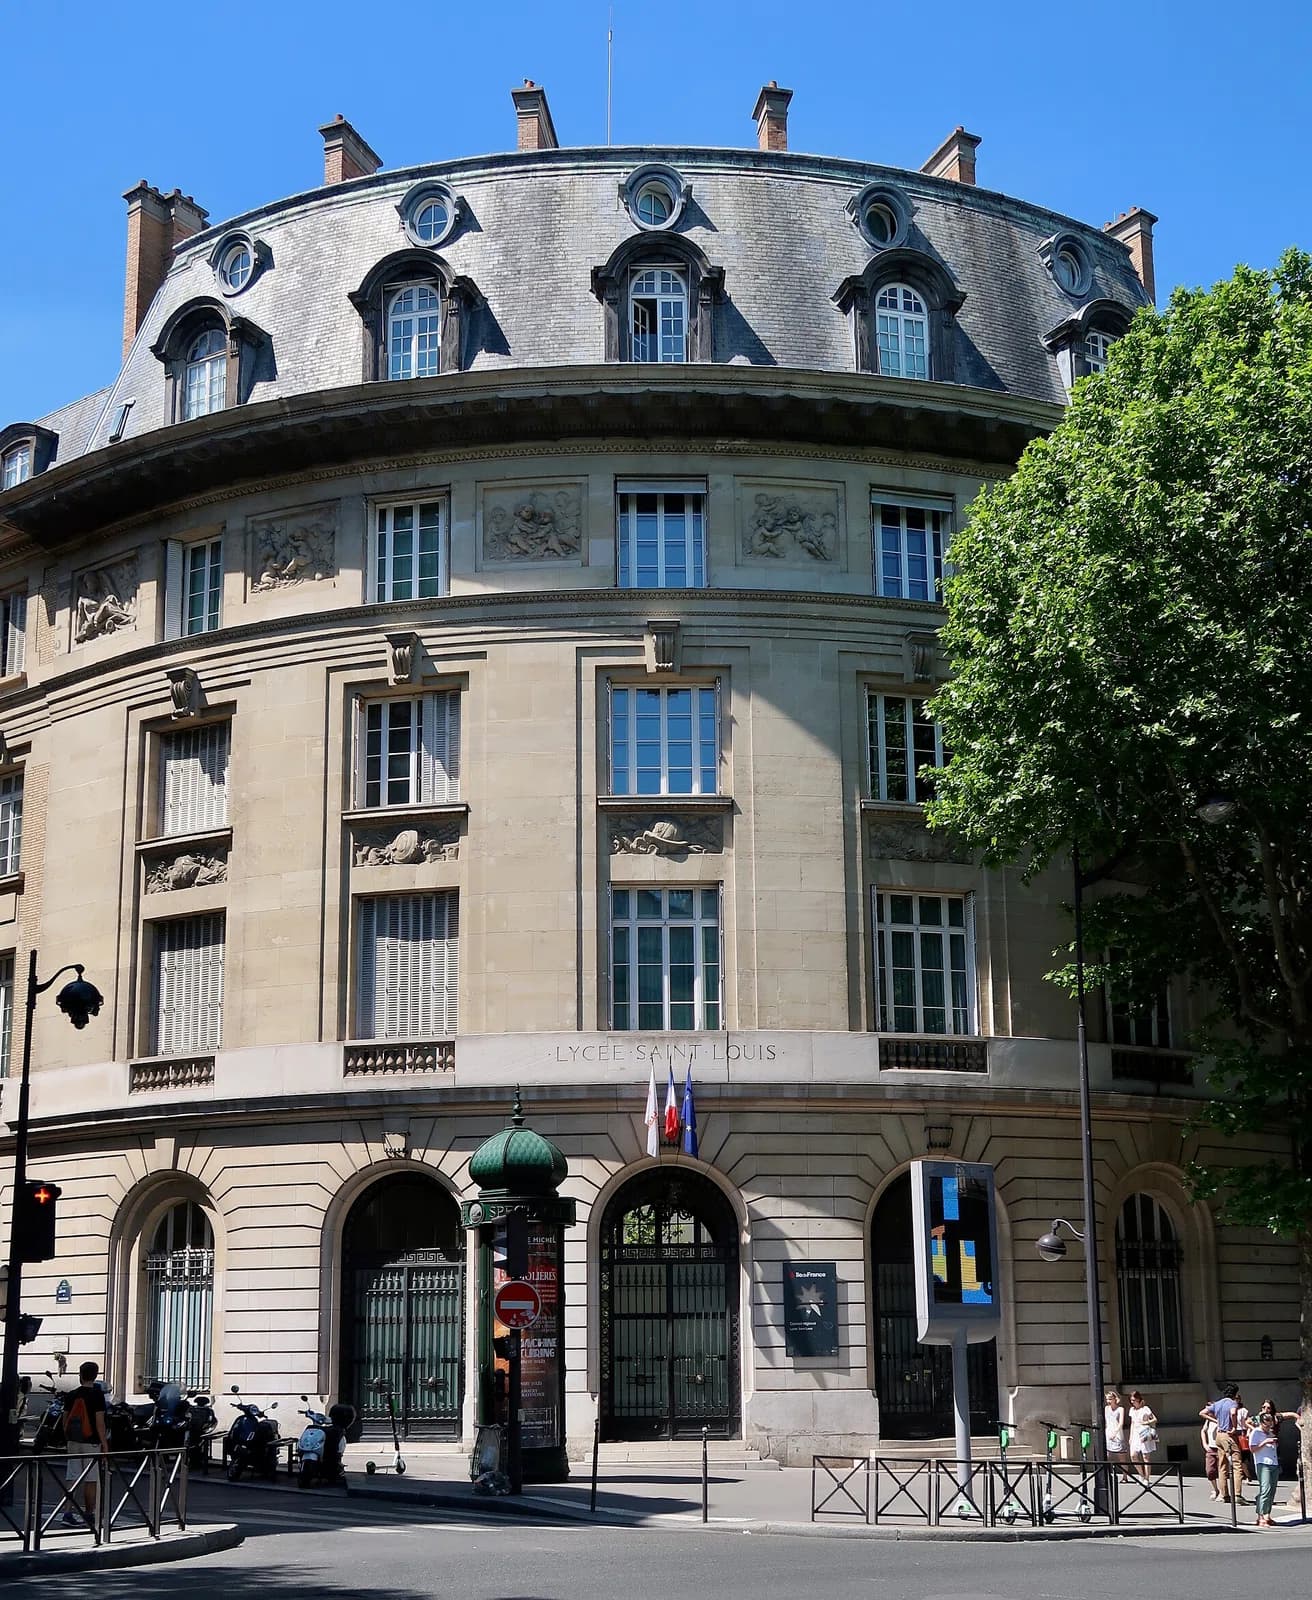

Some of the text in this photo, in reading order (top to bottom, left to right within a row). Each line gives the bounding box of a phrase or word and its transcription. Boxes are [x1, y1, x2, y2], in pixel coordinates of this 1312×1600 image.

[556, 1044, 776, 1062] LYCEE SAINT LOUIS
